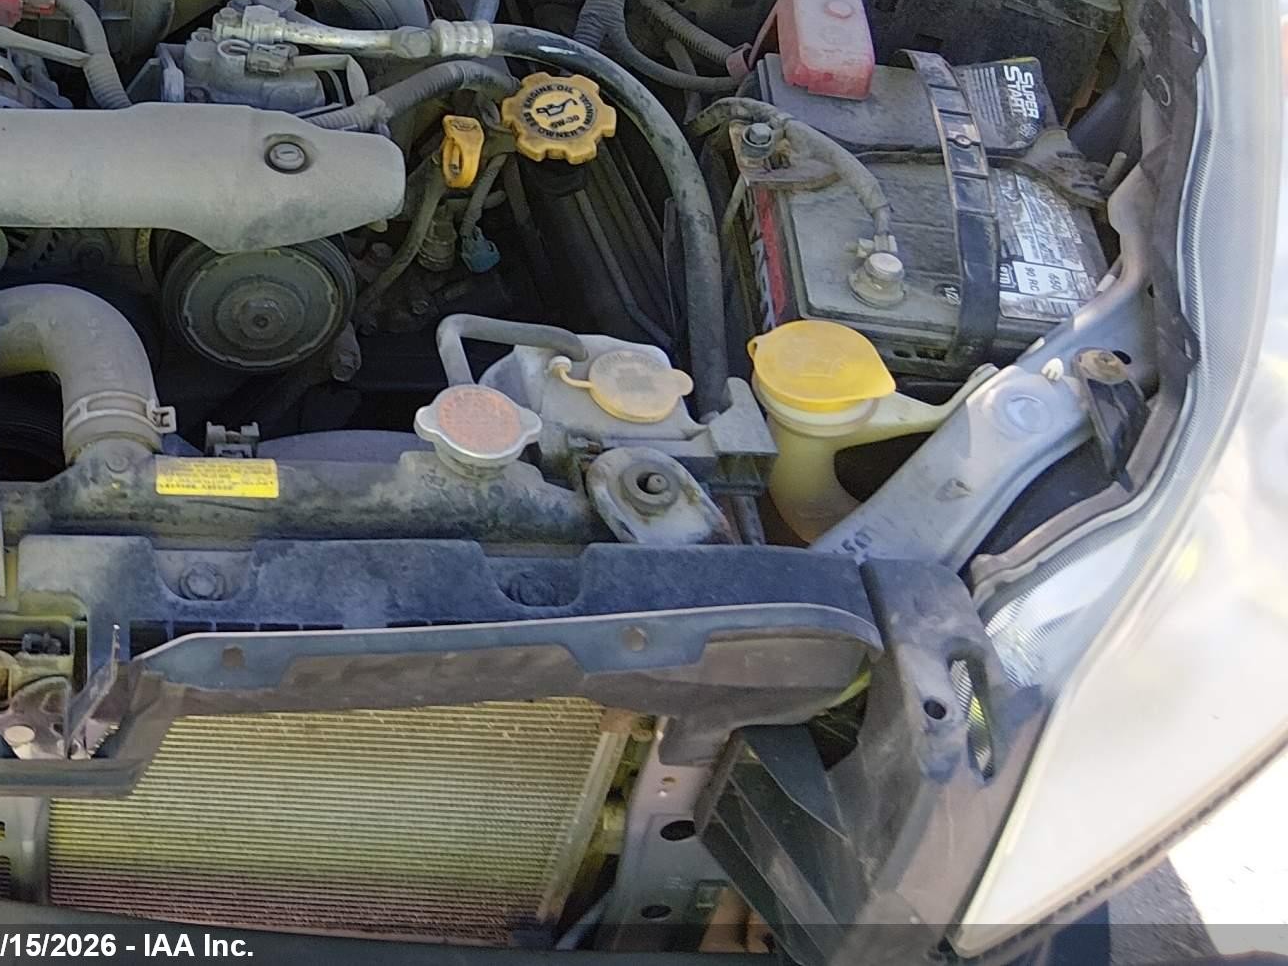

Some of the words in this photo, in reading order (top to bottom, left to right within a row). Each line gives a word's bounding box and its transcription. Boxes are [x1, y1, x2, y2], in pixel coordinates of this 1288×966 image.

[524, 84, 553, 107] ENGINE
[556, 84, 574, 94] OIL
[1003, 65, 1028, 117] START
[1021, 71, 1040, 119] SUPER
